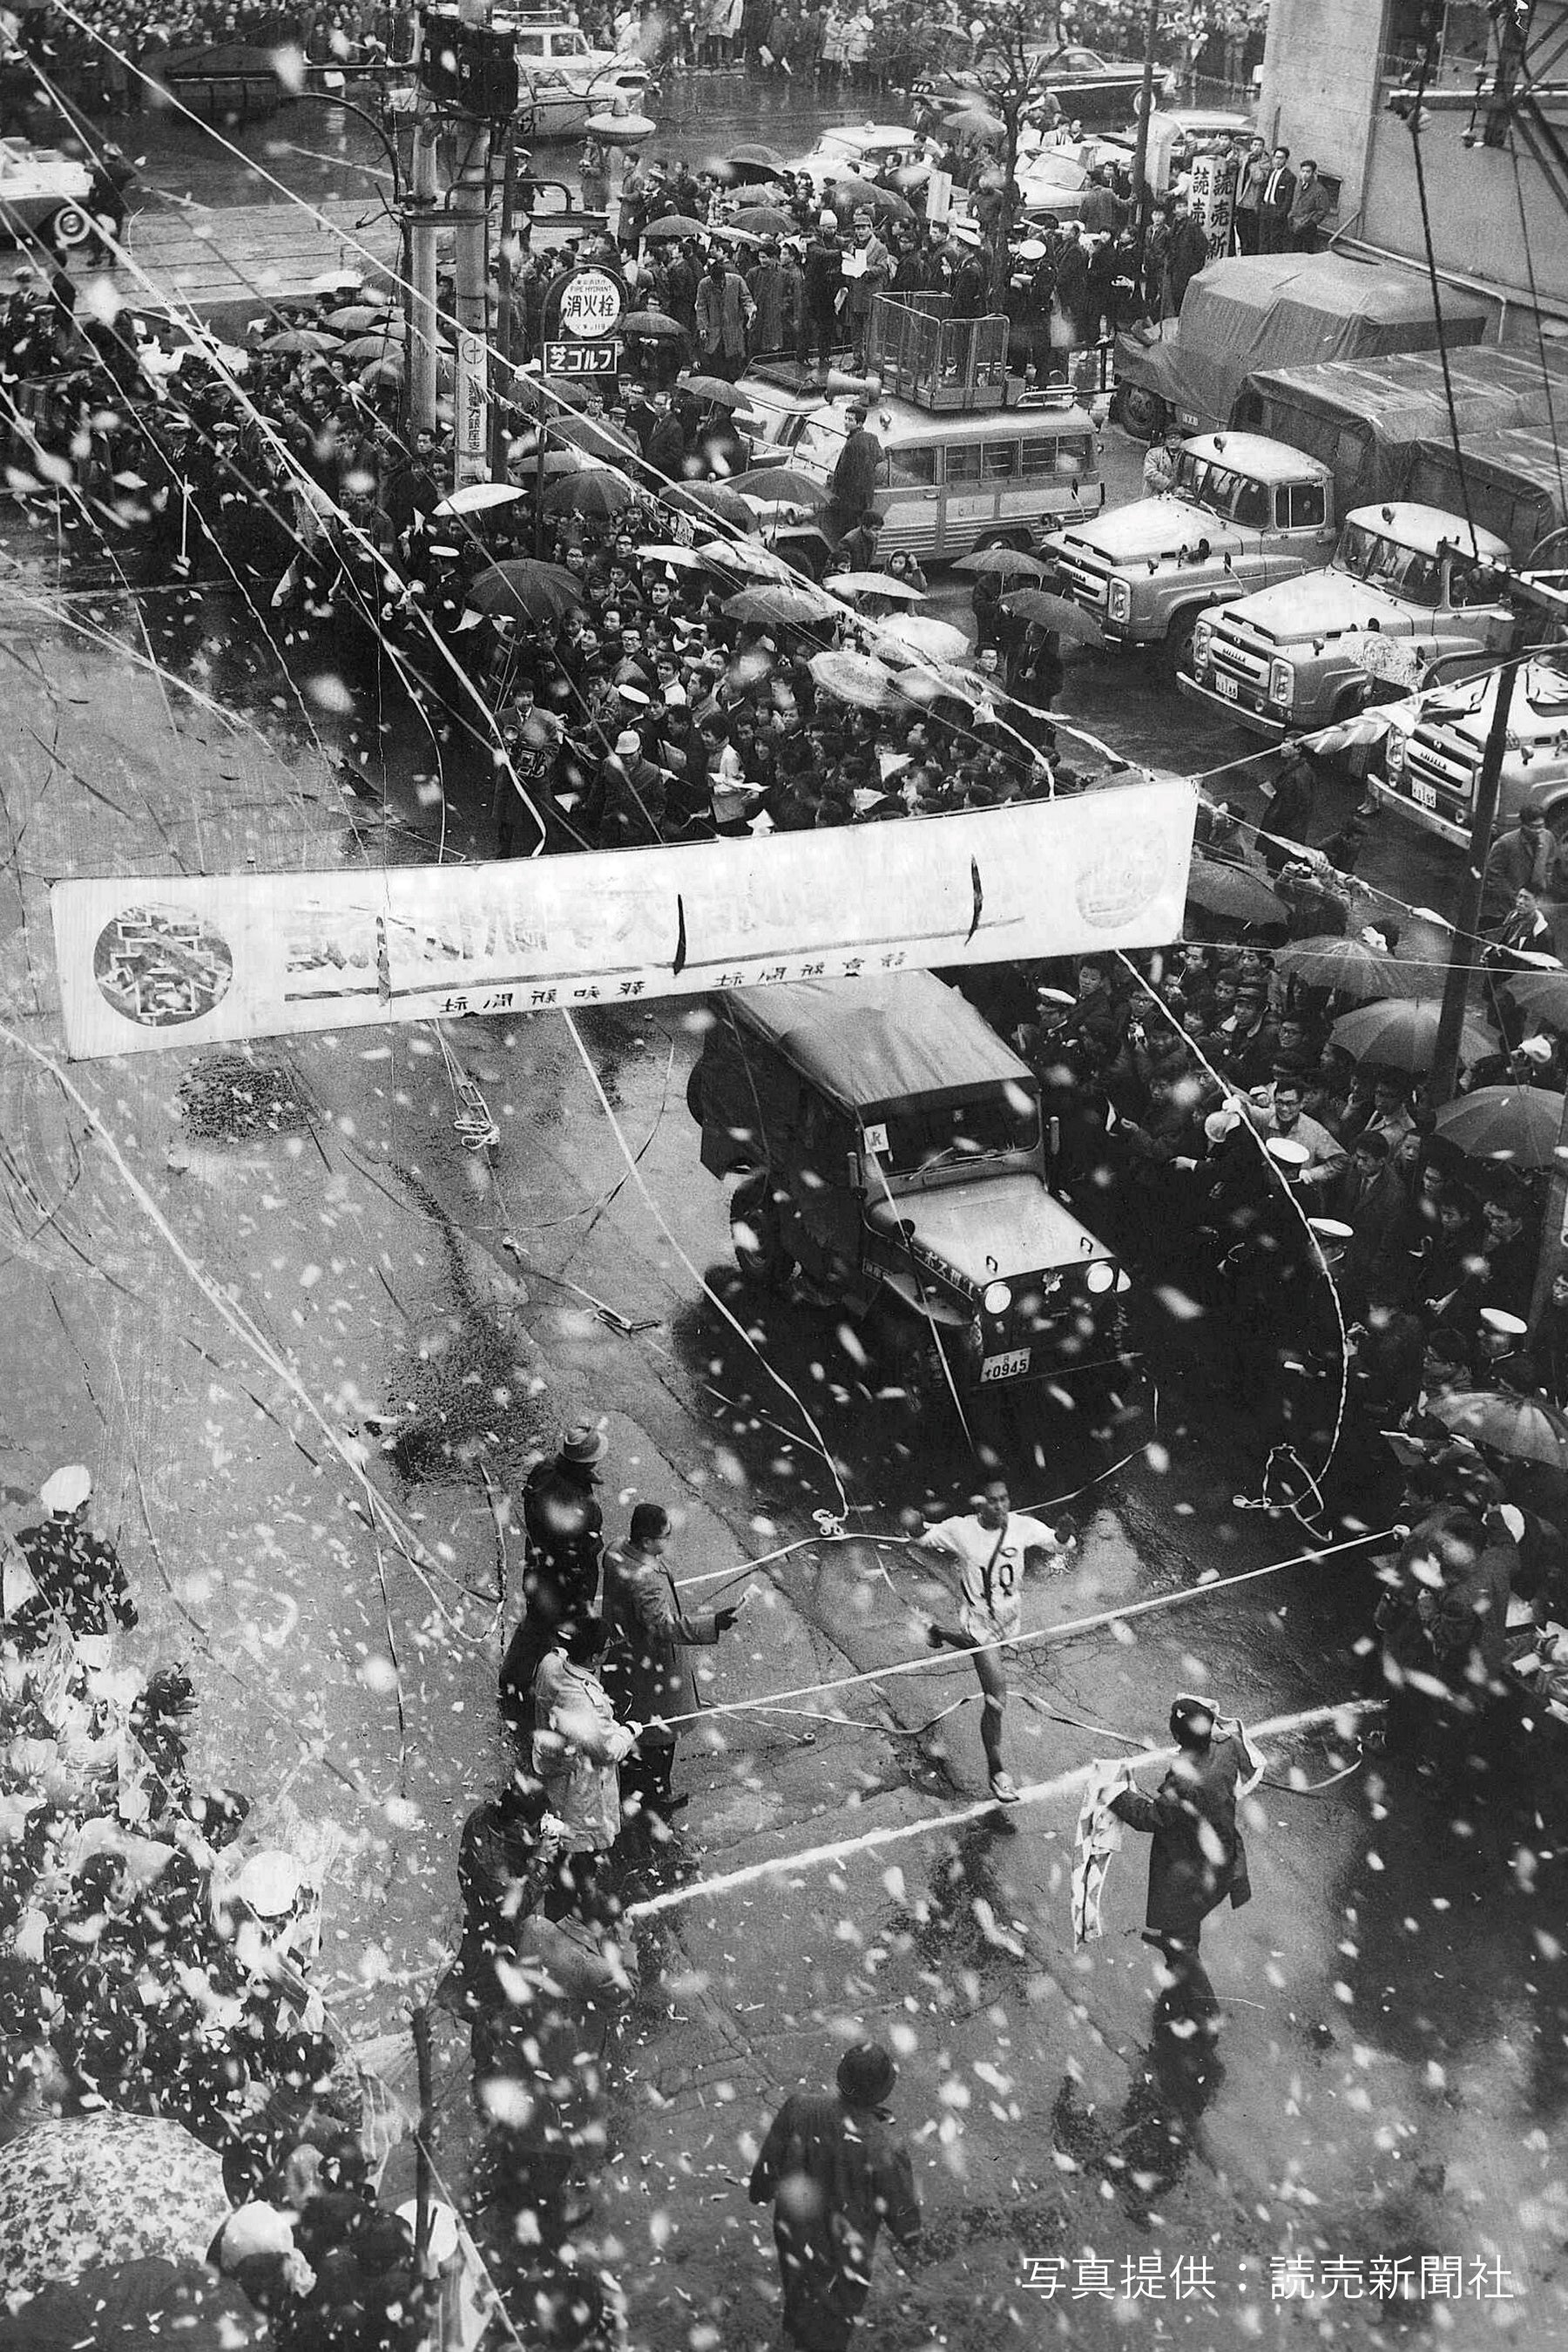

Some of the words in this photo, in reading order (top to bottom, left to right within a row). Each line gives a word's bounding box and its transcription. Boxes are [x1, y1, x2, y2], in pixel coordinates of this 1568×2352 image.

[566, 294, 614, 318] 消火栓
[550, 345, 612, 371] 芝ゴルフ
